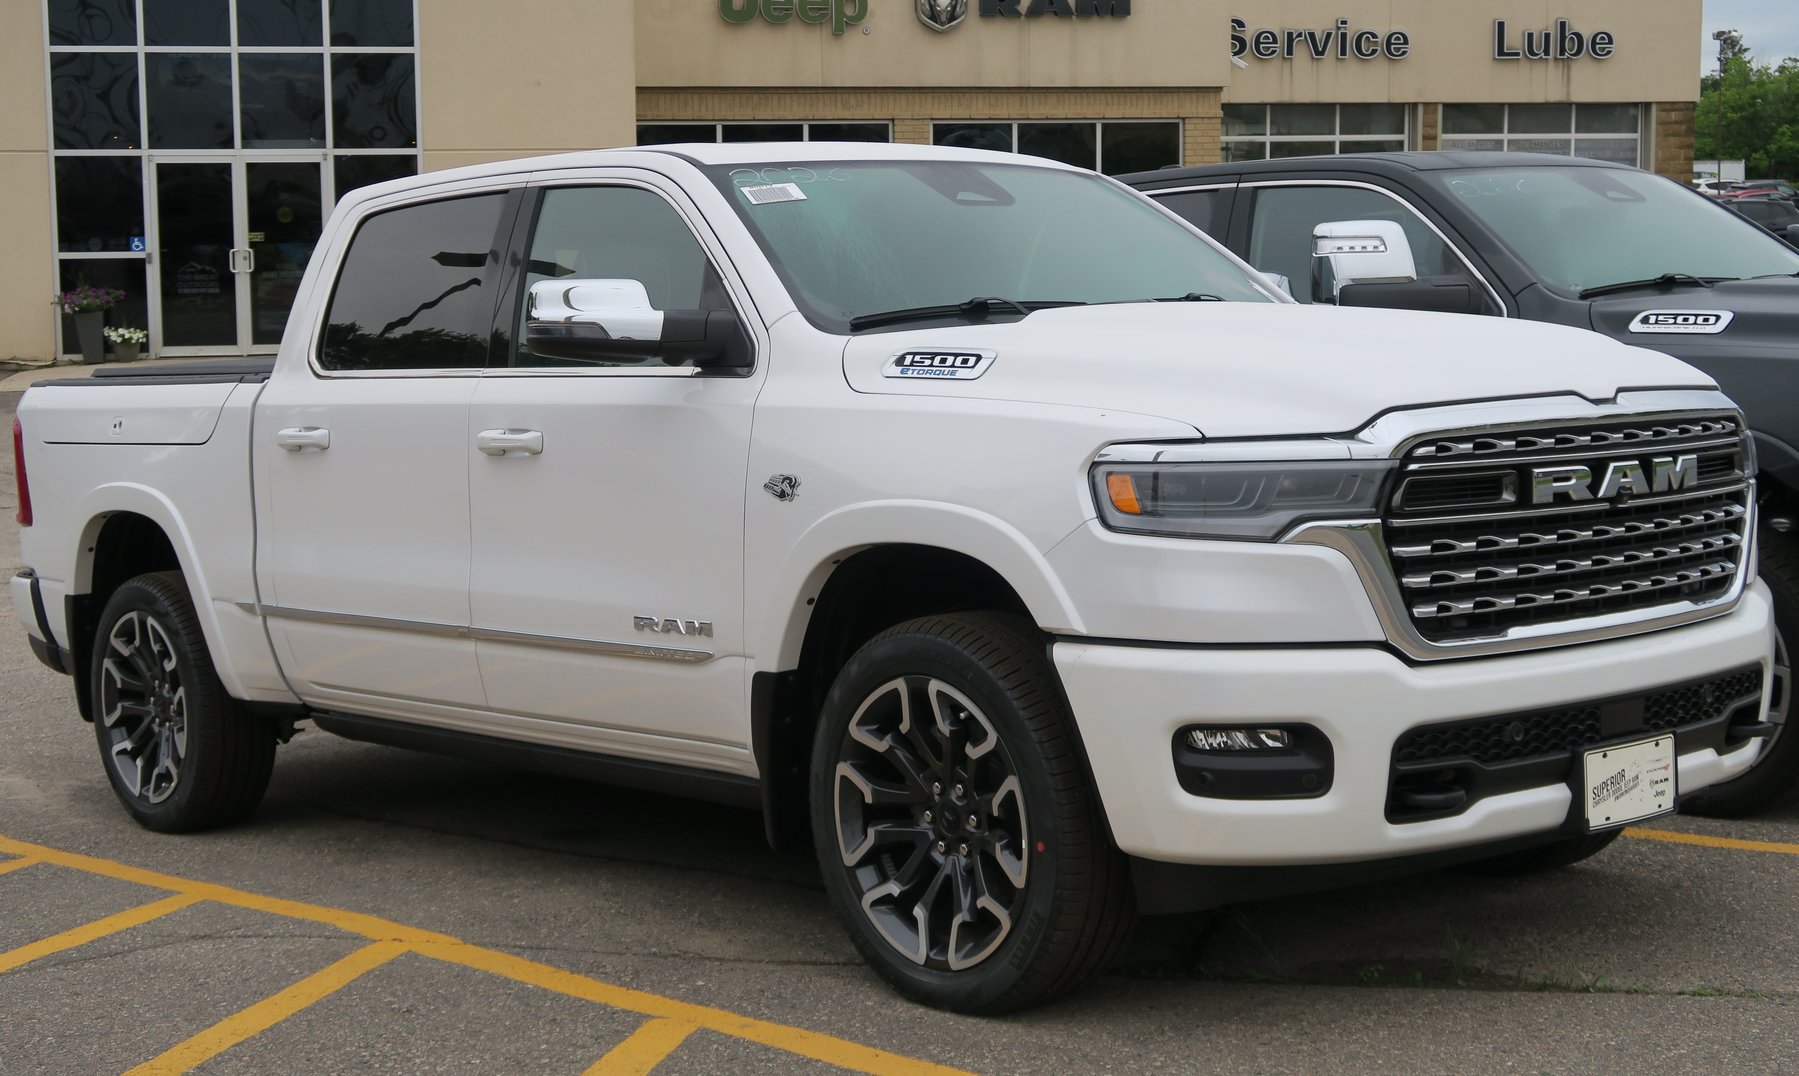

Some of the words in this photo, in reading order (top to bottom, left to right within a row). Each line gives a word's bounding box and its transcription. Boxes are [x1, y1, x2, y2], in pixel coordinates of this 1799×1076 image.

[1231, 16, 1412, 60] Service
[1493, 18, 1615, 60] Lube
[1648, 315, 1717, 325] 1500
[903, 355, 977, 367] 1500
[1532, 454, 1698, 504] RAM
[633, 616, 713, 637] RAM
[1592, 769, 1626, 800] SUPERIOR
